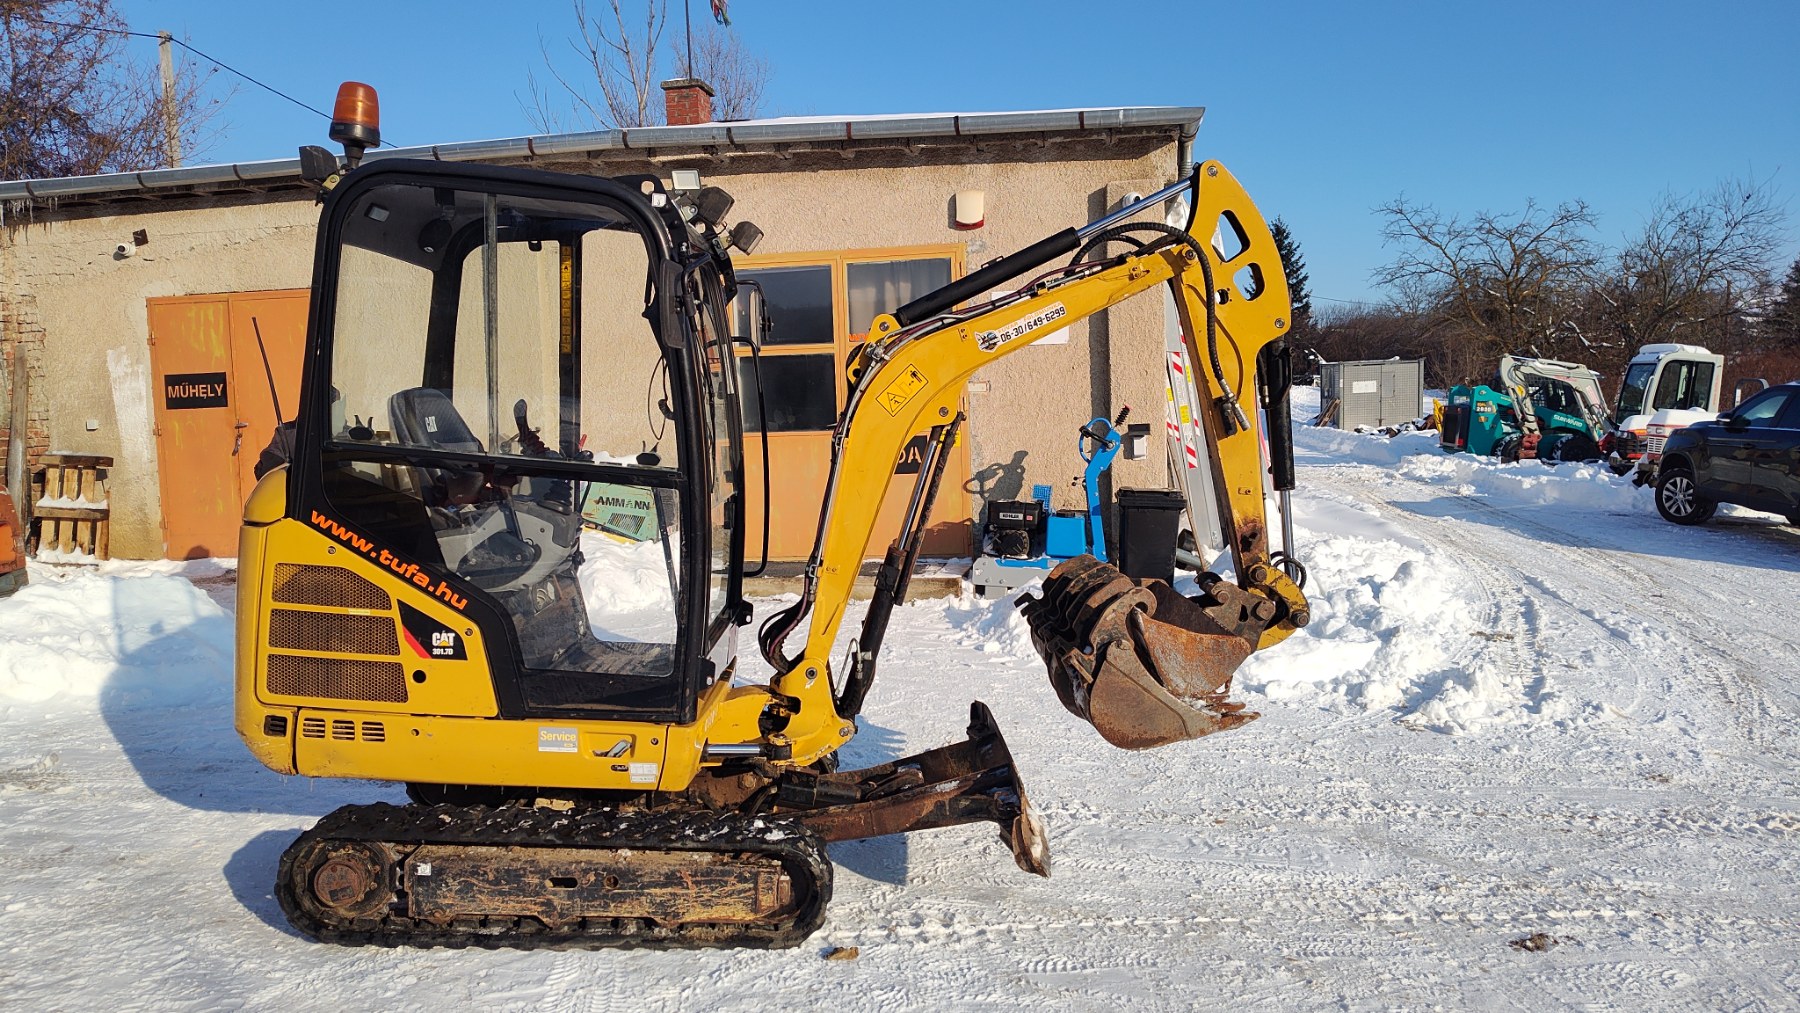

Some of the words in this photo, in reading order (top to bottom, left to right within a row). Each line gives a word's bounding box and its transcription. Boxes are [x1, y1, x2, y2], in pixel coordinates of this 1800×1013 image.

[1000, 306, 1066, 343] 06-30/649-6299
[167, 382, 224, 399] MŰHELY
[1553, 414, 1583, 428] SUNWARD
[596, 495, 650, 510] AMMANN
[311, 509, 468, 610] www.tufa.hu
[432, 630, 455, 647] CAT
[432, 647, 454, 655] 301.7D
[540, 730, 576, 741] Service
